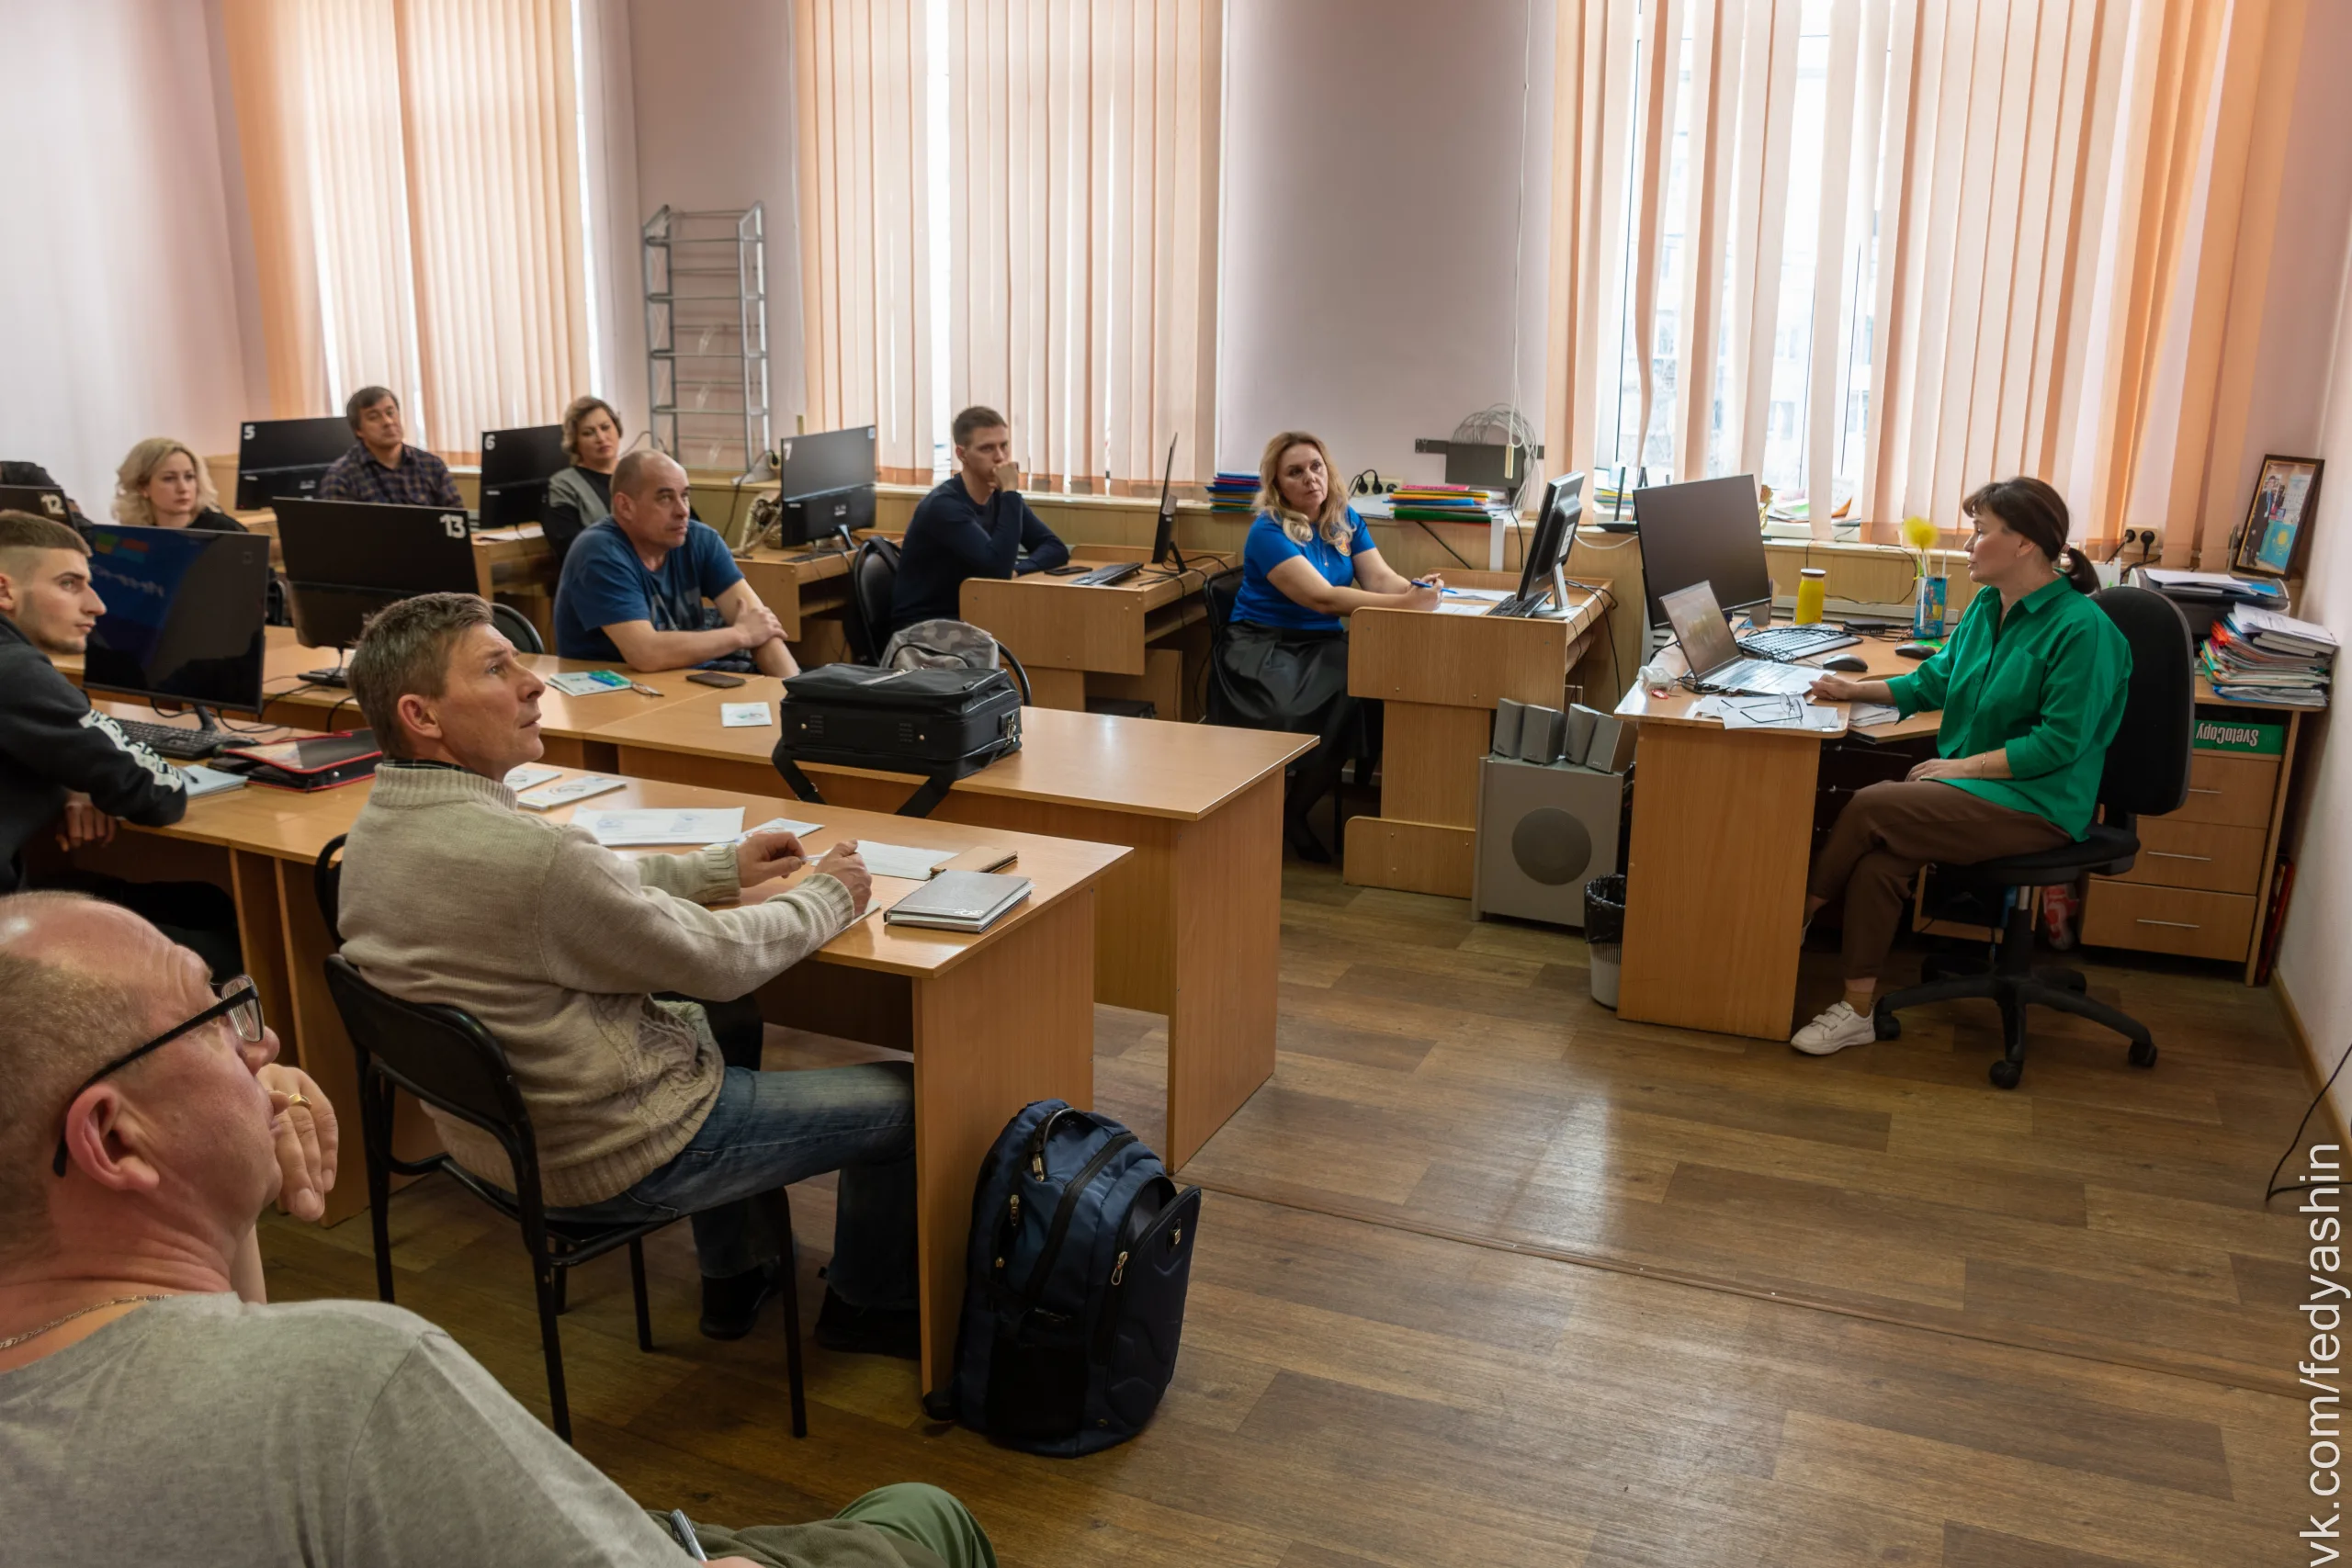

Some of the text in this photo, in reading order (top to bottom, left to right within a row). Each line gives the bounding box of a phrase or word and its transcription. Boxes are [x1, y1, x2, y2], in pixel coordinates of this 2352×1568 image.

[243, 424, 255, 440] 5
[484, 434, 496, 451] 6
[784, 443, 792, 461] 7
[40, 494, 66, 514] 12
[439, 513, 467, 538] 13
[2195, 723, 2259, 747] SvetoCopy
